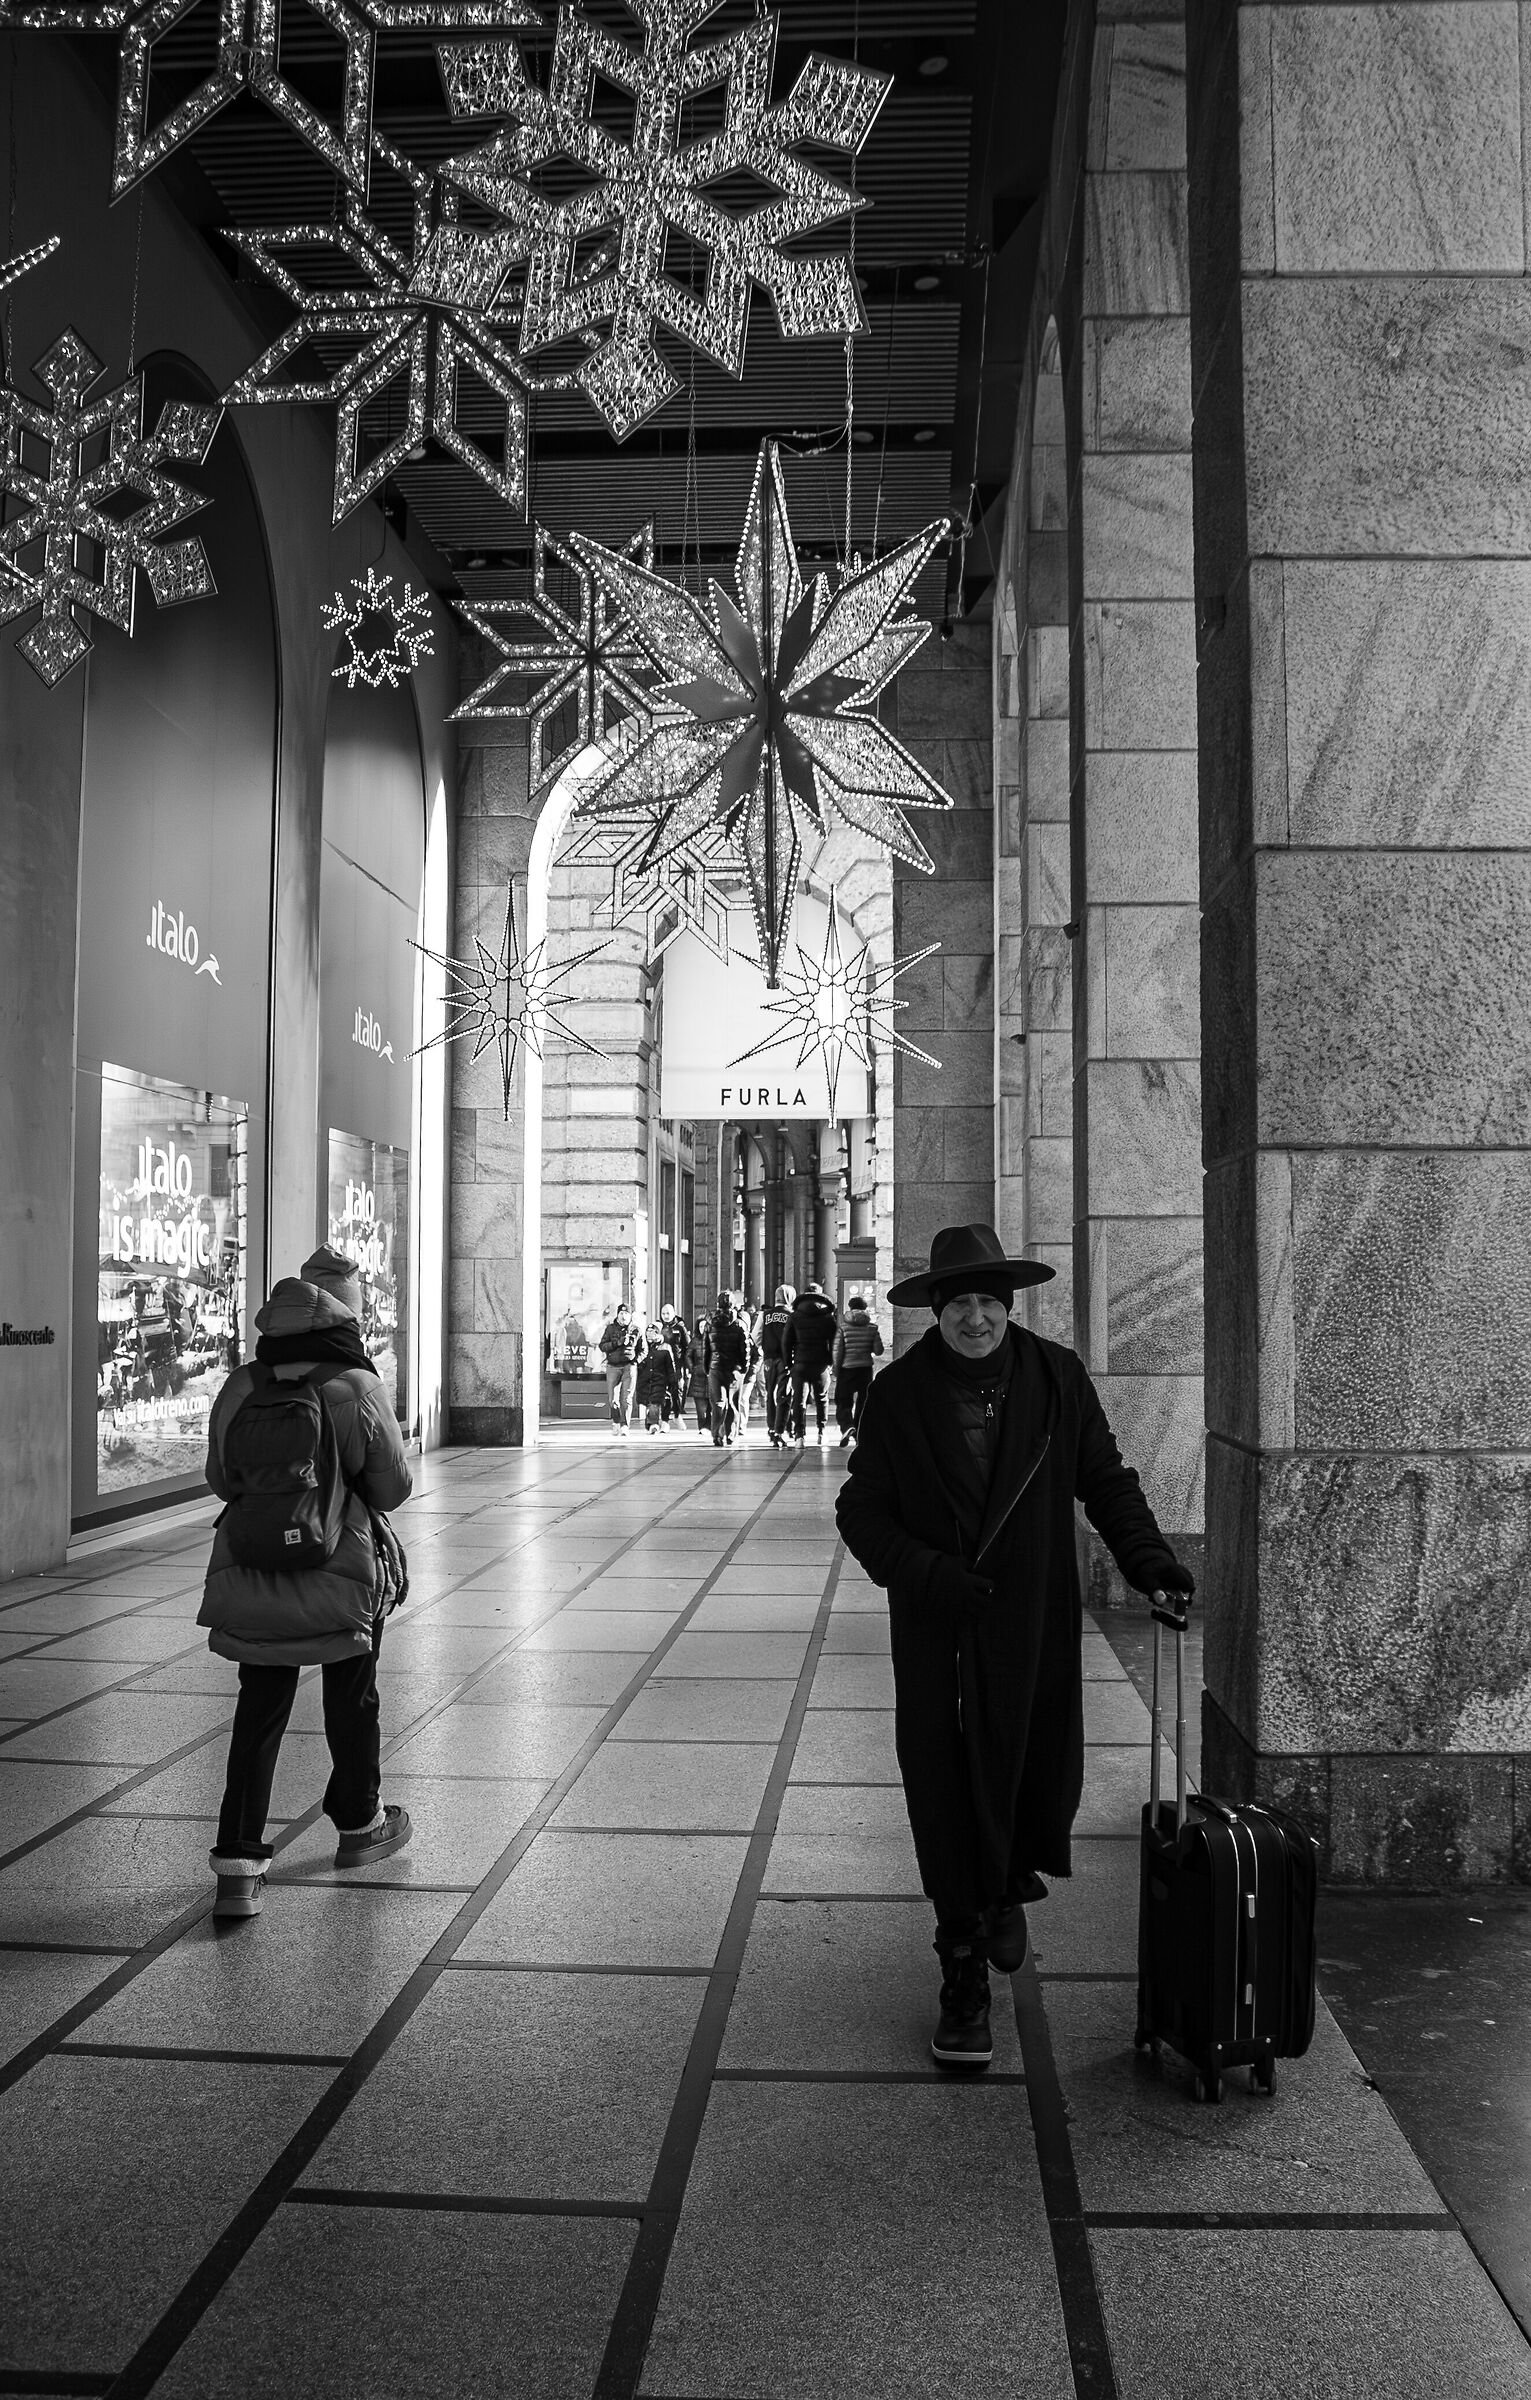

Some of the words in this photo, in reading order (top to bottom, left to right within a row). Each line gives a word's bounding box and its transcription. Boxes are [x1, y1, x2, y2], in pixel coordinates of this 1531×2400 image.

[721, 1088, 807, 1106] FURLA
[113, 1198, 134, 1263] is
[140, 1207, 209, 1278] magic
[136, 1394, 209, 1424] italotreno.com
